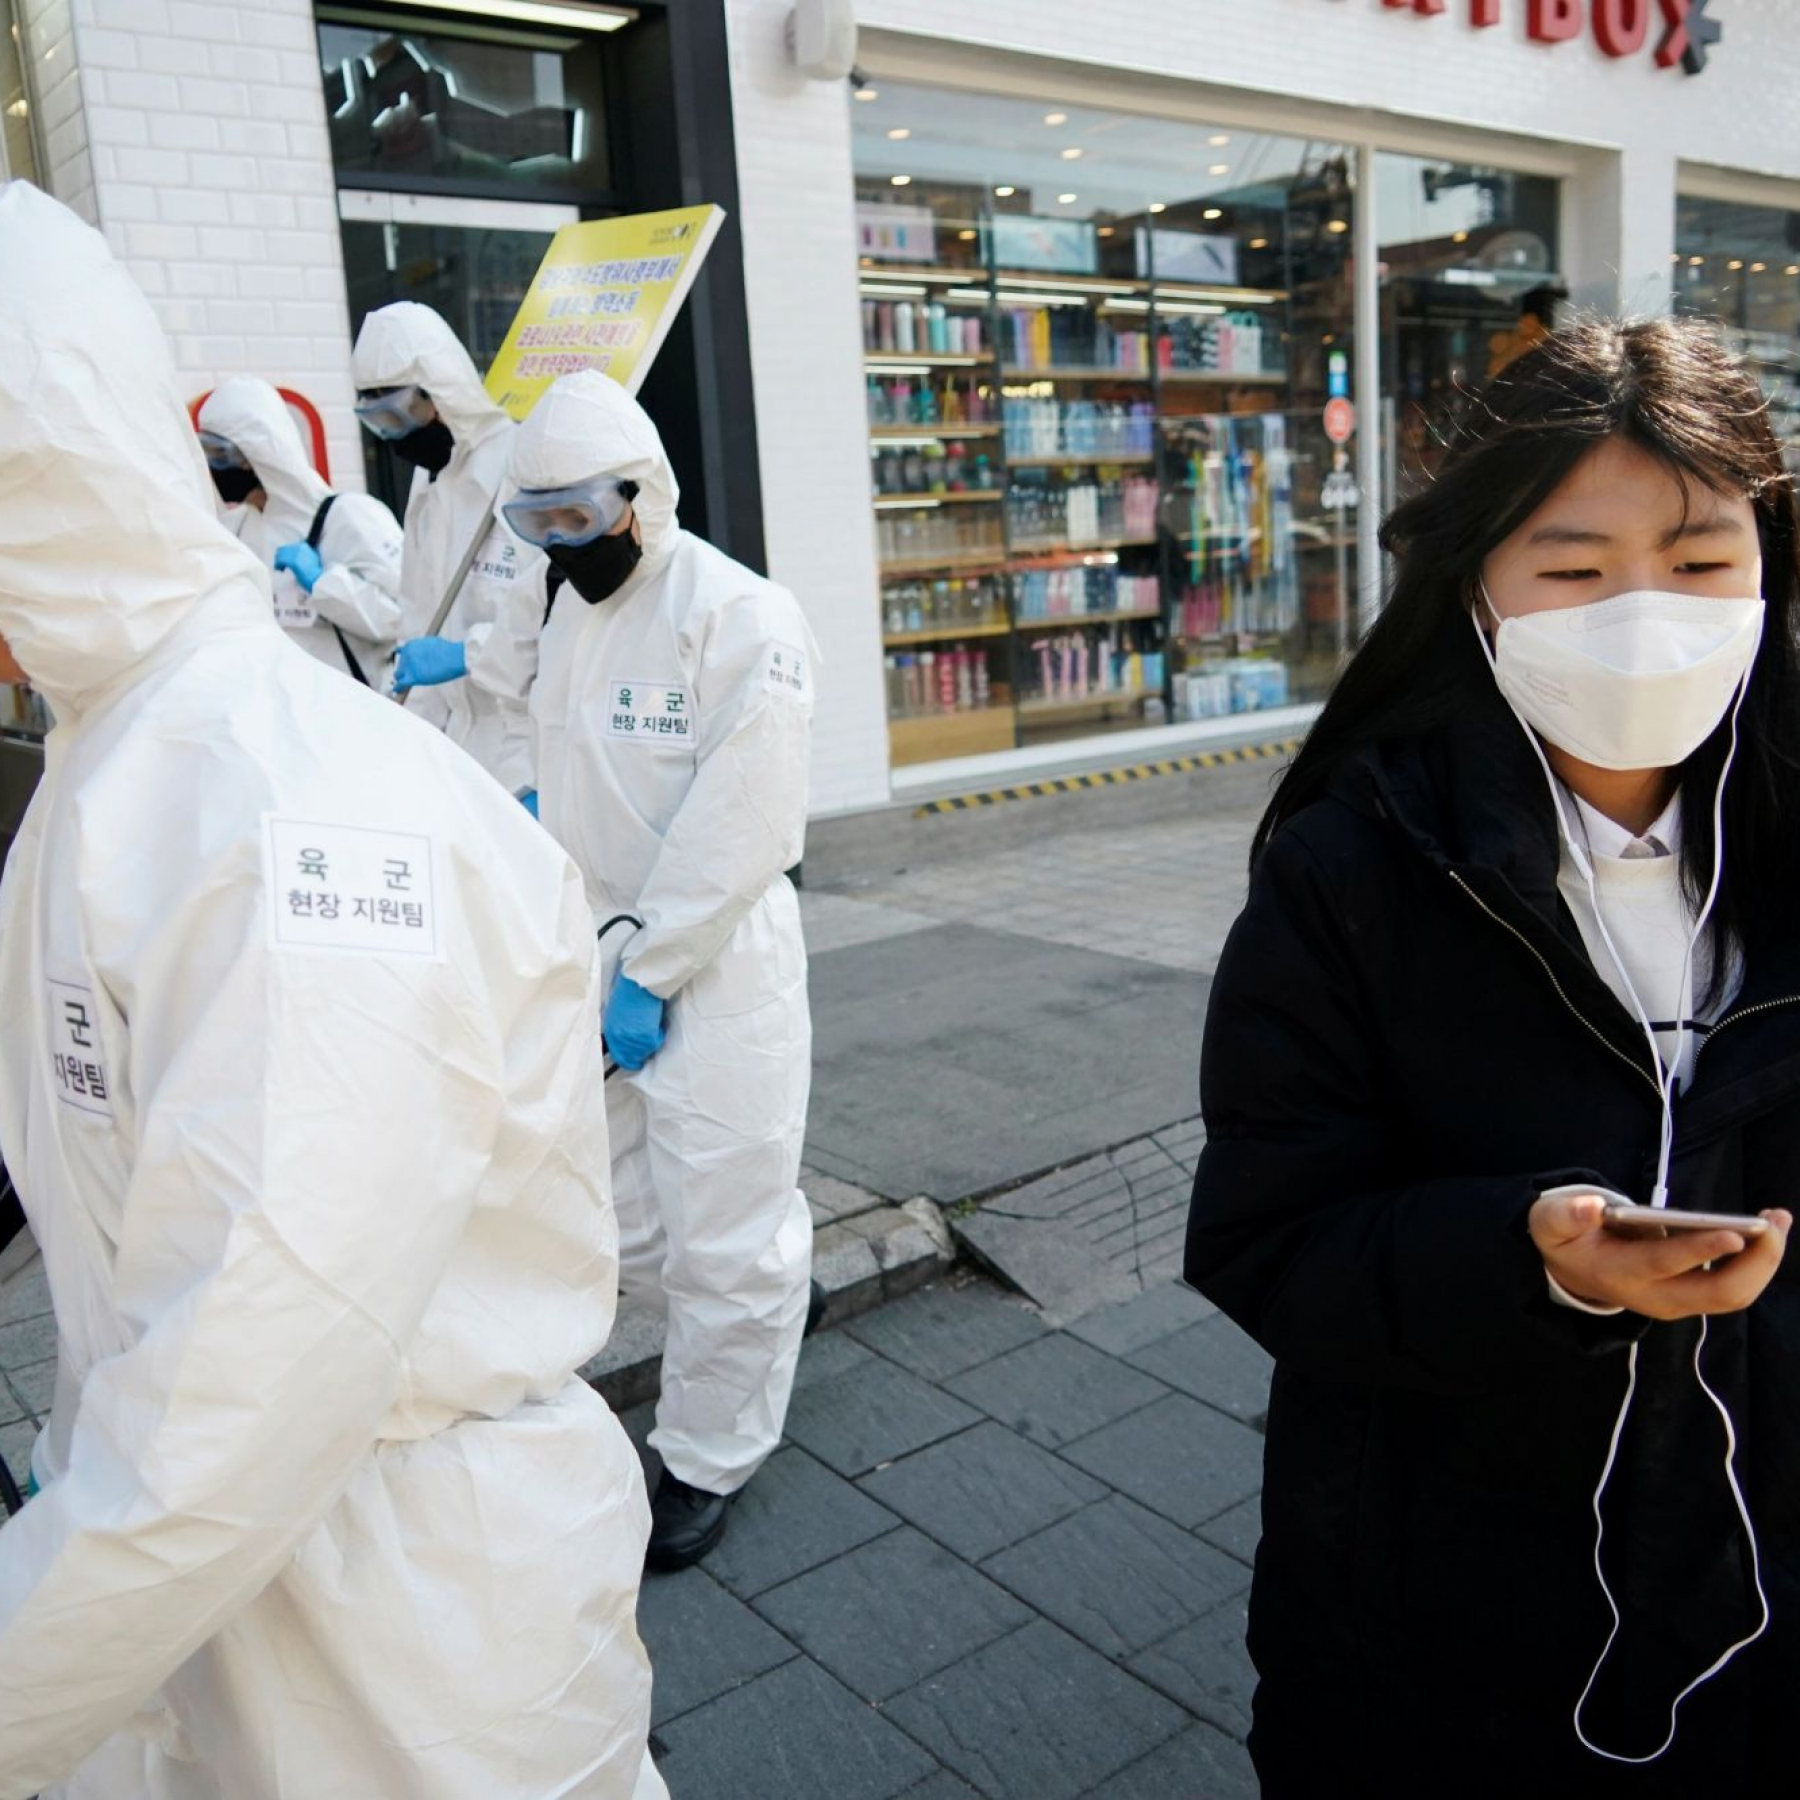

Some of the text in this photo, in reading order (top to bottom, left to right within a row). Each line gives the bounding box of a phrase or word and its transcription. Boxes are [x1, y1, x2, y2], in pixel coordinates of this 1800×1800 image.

[618, 687, 686, 713] 육 군
[611, 712, 689, 735] 현장 지원팀
[297, 847, 413, 891] 육 군
[288, 888, 425, 929] 현장 지원팀
[64, 1000, 93, 1049] 군
[53, 1052, 108, 1102] 지원팀
